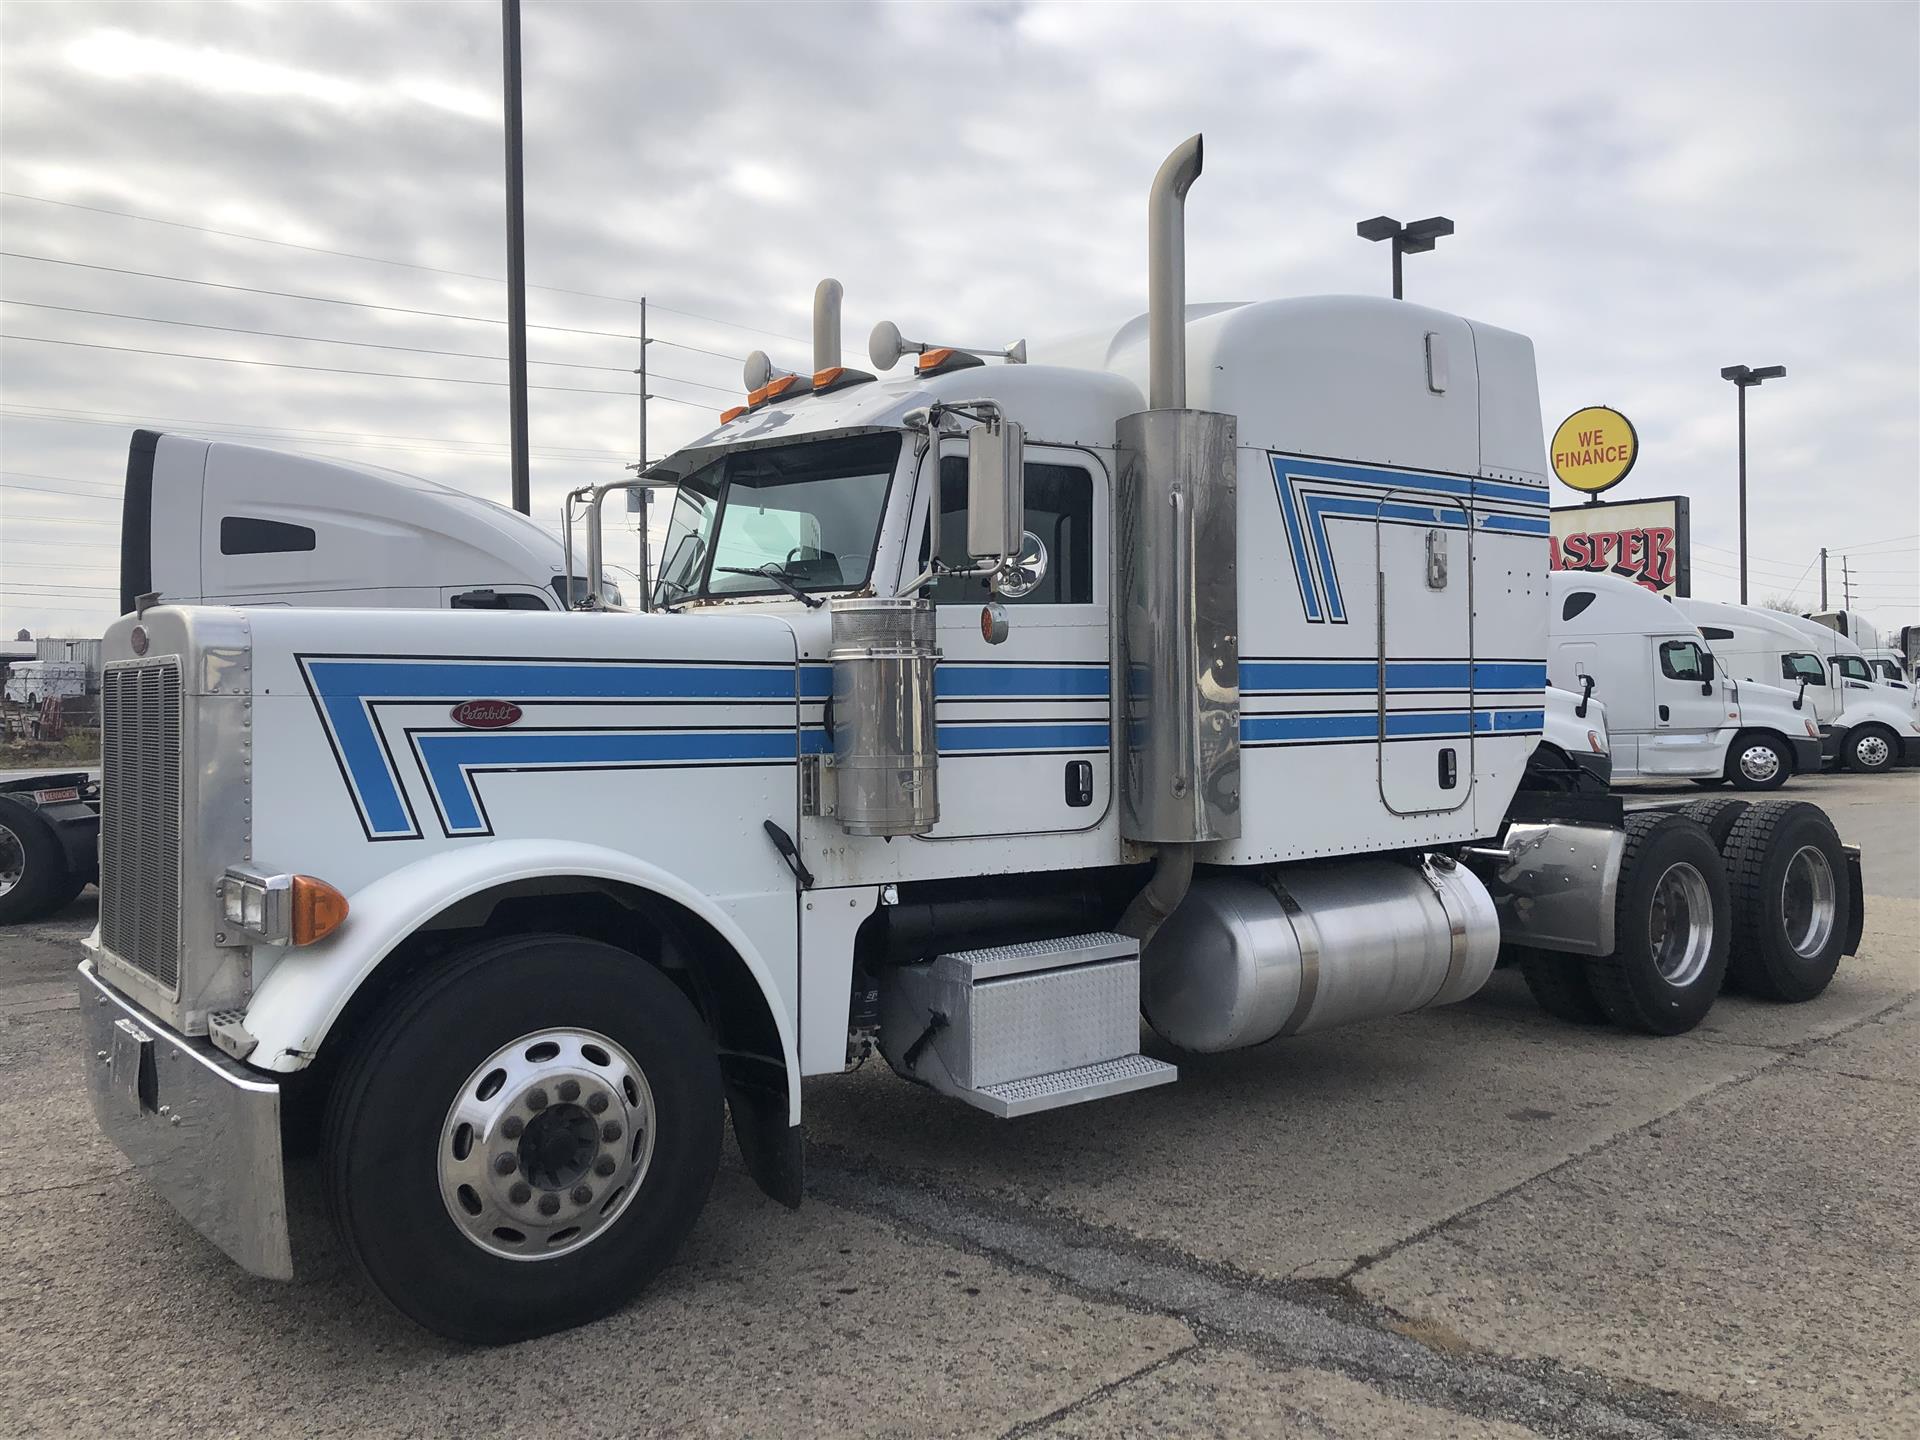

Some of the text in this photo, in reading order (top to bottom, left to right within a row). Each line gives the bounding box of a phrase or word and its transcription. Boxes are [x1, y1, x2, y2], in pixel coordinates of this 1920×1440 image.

[1578, 430, 1603, 447] WE
[1555, 445, 1628, 469] FINANCE
[460, 704, 517, 721] Peterbilt
